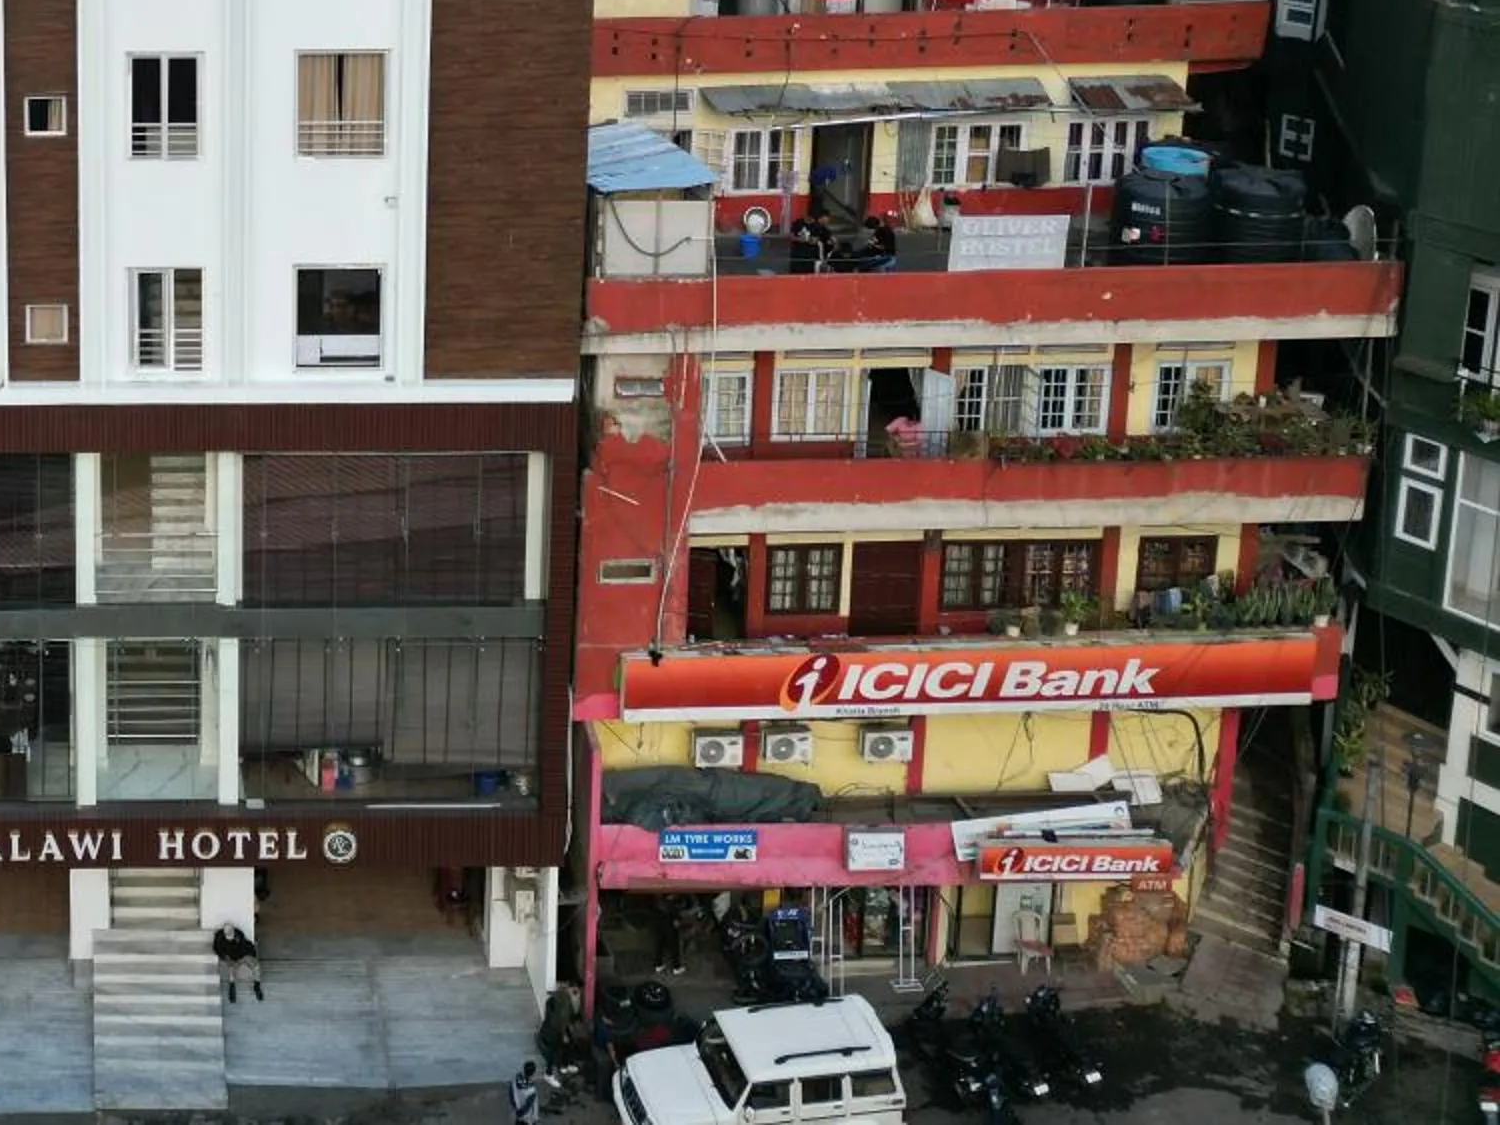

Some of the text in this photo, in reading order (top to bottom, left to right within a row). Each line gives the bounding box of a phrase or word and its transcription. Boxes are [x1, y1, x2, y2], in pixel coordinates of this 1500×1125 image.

[837, 662, 994, 701] ICICI
[1000, 658, 1160, 698] Bank
[158, 829, 308, 860] HOTEL
[665, 834, 753, 844] LM TYRE WORKS
[1023, 855, 1087, 872] ICICI
[1092, 855, 1161, 872] Bank
[1137, 879, 1167, 890] ATM
